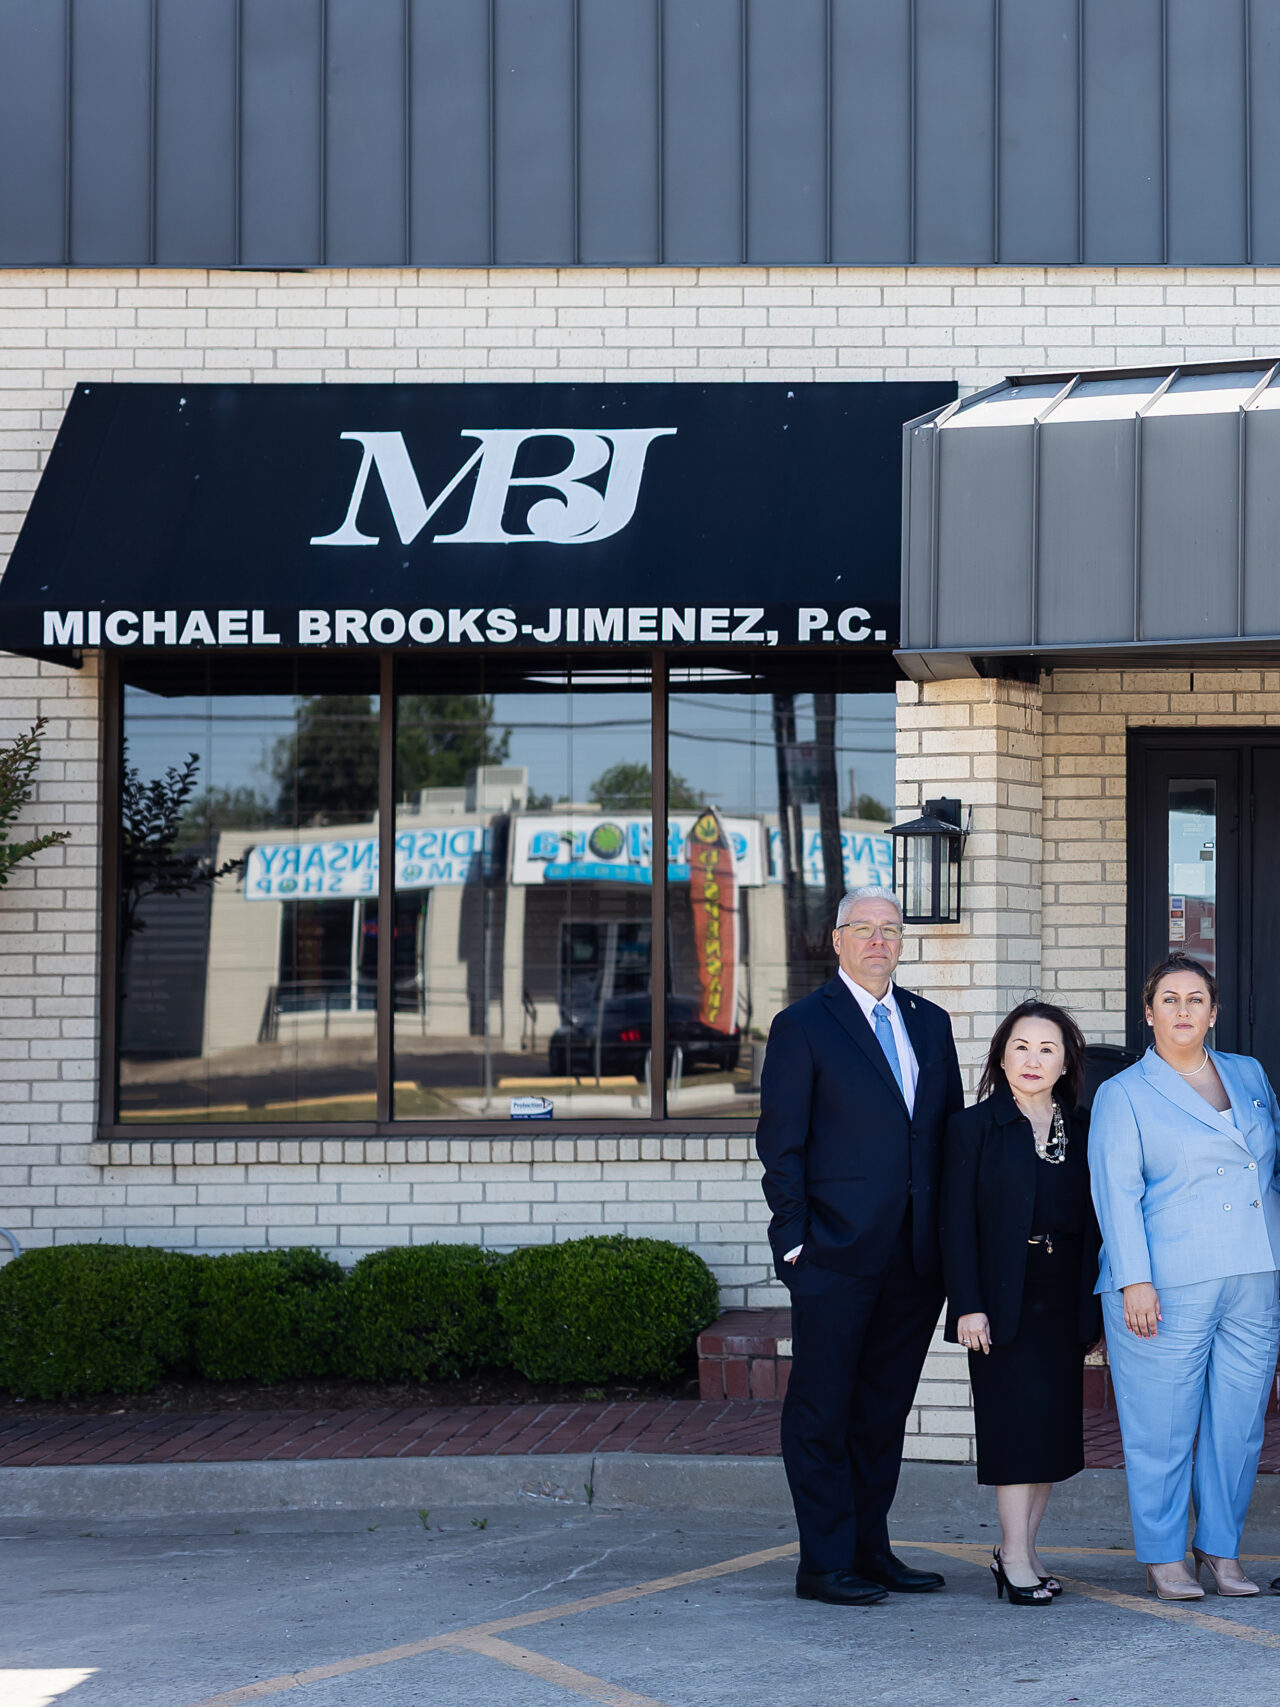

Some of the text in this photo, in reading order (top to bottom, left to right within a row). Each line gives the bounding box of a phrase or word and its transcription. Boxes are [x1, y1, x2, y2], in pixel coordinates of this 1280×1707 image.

[310, 428, 678, 545] MBJ
[43, 606, 888, 646] MICHAEL BROOKS-JIMENEZ, P.C.
